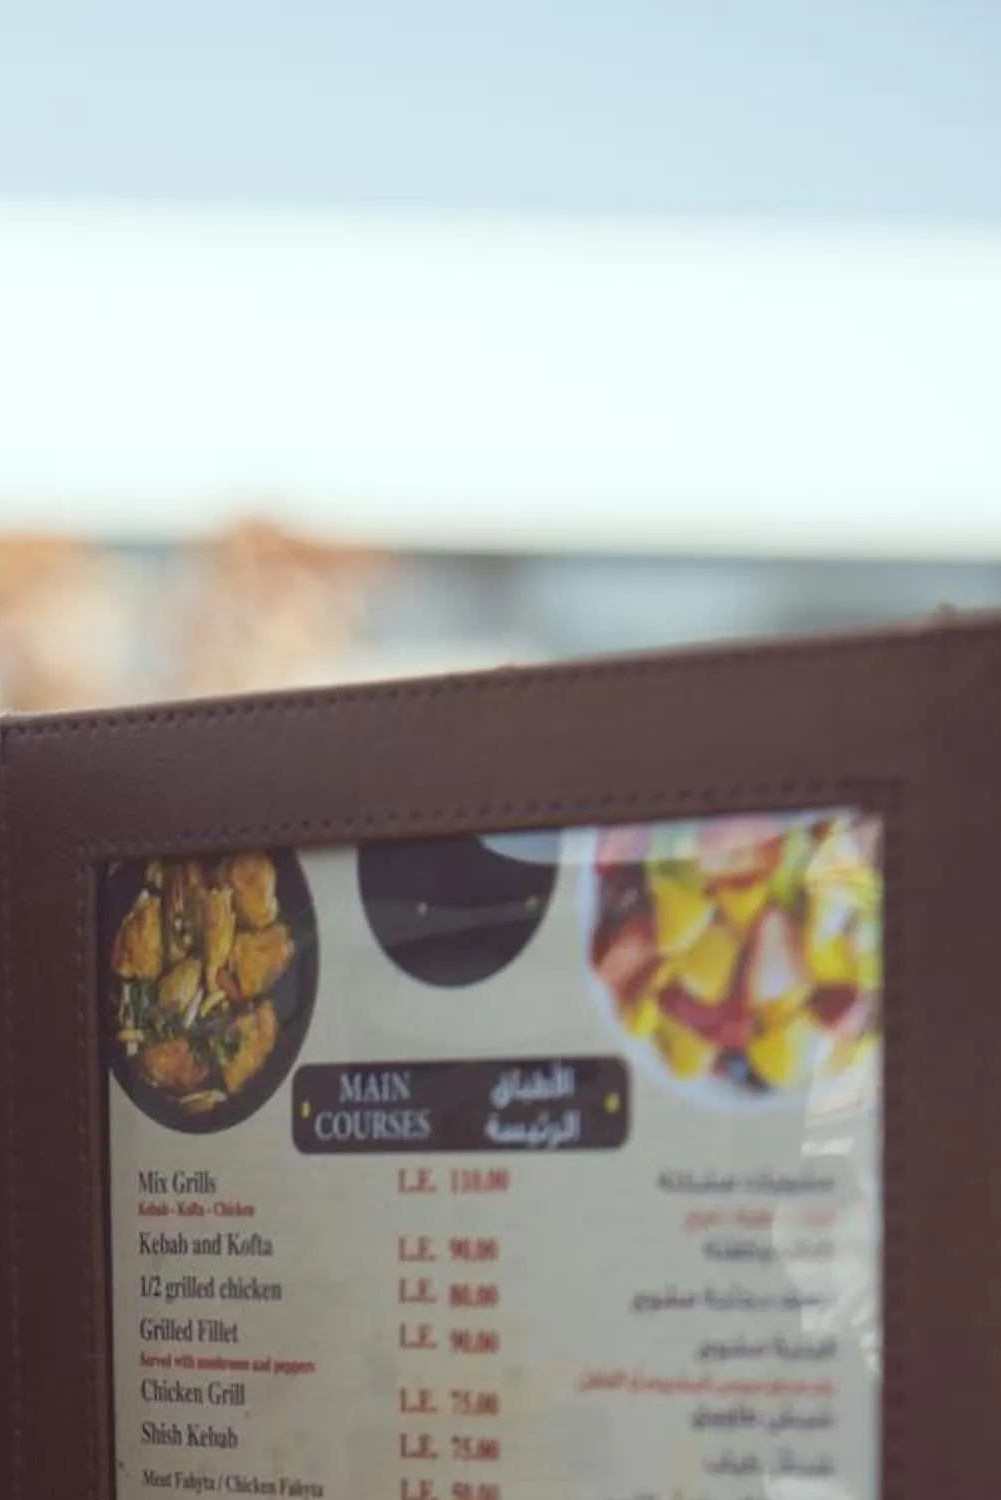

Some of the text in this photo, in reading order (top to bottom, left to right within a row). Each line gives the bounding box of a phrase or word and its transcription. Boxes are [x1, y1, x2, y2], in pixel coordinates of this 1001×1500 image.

[340, 1071, 411, 1103] MAIN
[314, 1109, 432, 1141] COURSES
[137, 1170, 217, 1195] Mix Grills
[213, 1201, 255, 1218] Chicken
[138, 1231, 274, 1257] Kebab and Kofta
[140, 1275, 283, 1303] 1/2 grilled chicken
[139, 1318, 239, 1344] Grilled Fillet
[174, 1353, 195, 1370] with
[140, 1378, 246, 1407] Chicken Grill
[141, 1421, 238, 1449] Shish Kebab
[399, 1433, 439, 1459] L.E.
[142, 1469, 173, 1488] Meat
[225, 1475, 277, 1496] Chicken
